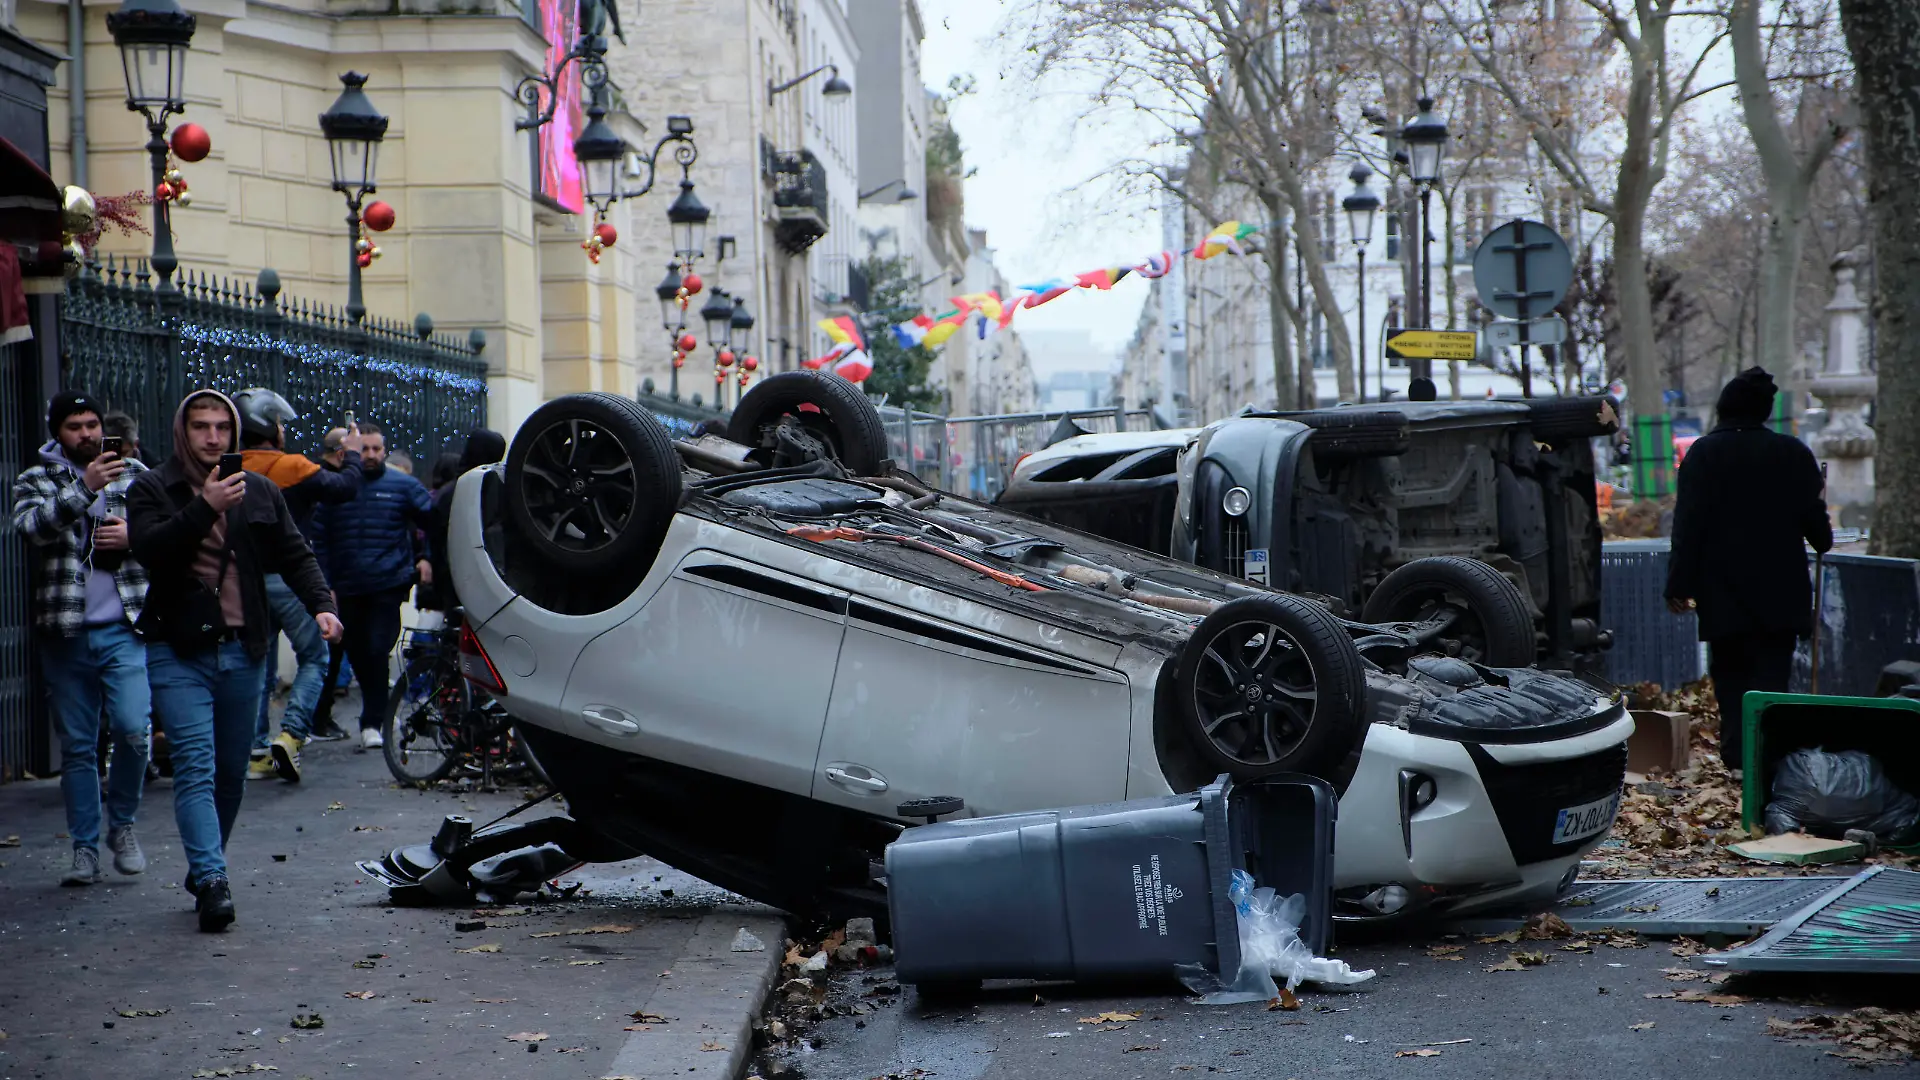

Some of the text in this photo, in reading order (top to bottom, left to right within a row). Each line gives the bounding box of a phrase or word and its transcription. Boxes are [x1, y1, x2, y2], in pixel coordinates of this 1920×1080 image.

[1132, 864, 1142, 885] UTILISEZ
[1151, 861, 1161, 880] DÉPOSEZ
[1153, 880, 1162, 890] RIEN
[1166, 884, 1174, 903] PARIS
[1135, 892, 1144, 903] BAC
[1143, 874, 1156, 919] TRIEZ VOS DÉCHETS
[1154, 890, 1163, 900] SUR
[1137, 902, 1150, 930] APPROPRIÉ
[1156, 905, 1165, 915] VOIE
[1157, 915, 1168, 936] PUBLIQUE
